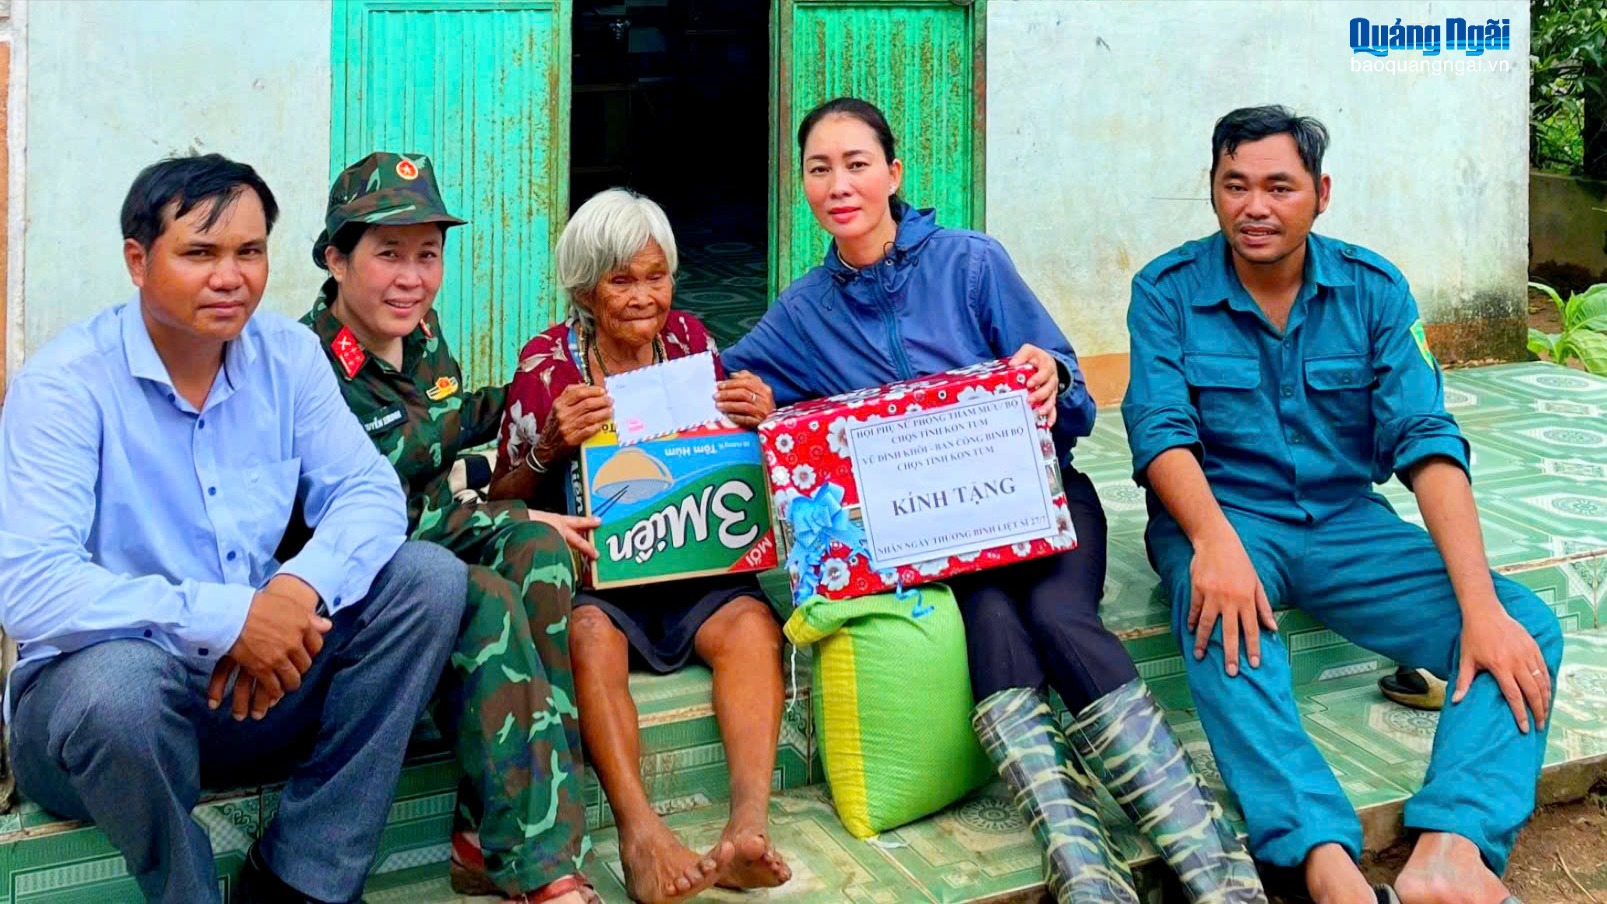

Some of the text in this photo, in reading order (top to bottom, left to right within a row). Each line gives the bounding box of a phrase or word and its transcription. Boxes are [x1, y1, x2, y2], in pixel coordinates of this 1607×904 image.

[892, 477, 1015, 517] KÍNH TẶNG
[605, 479, 758, 564] 3 Miền
[745, 536, 772, 567] MỚI
